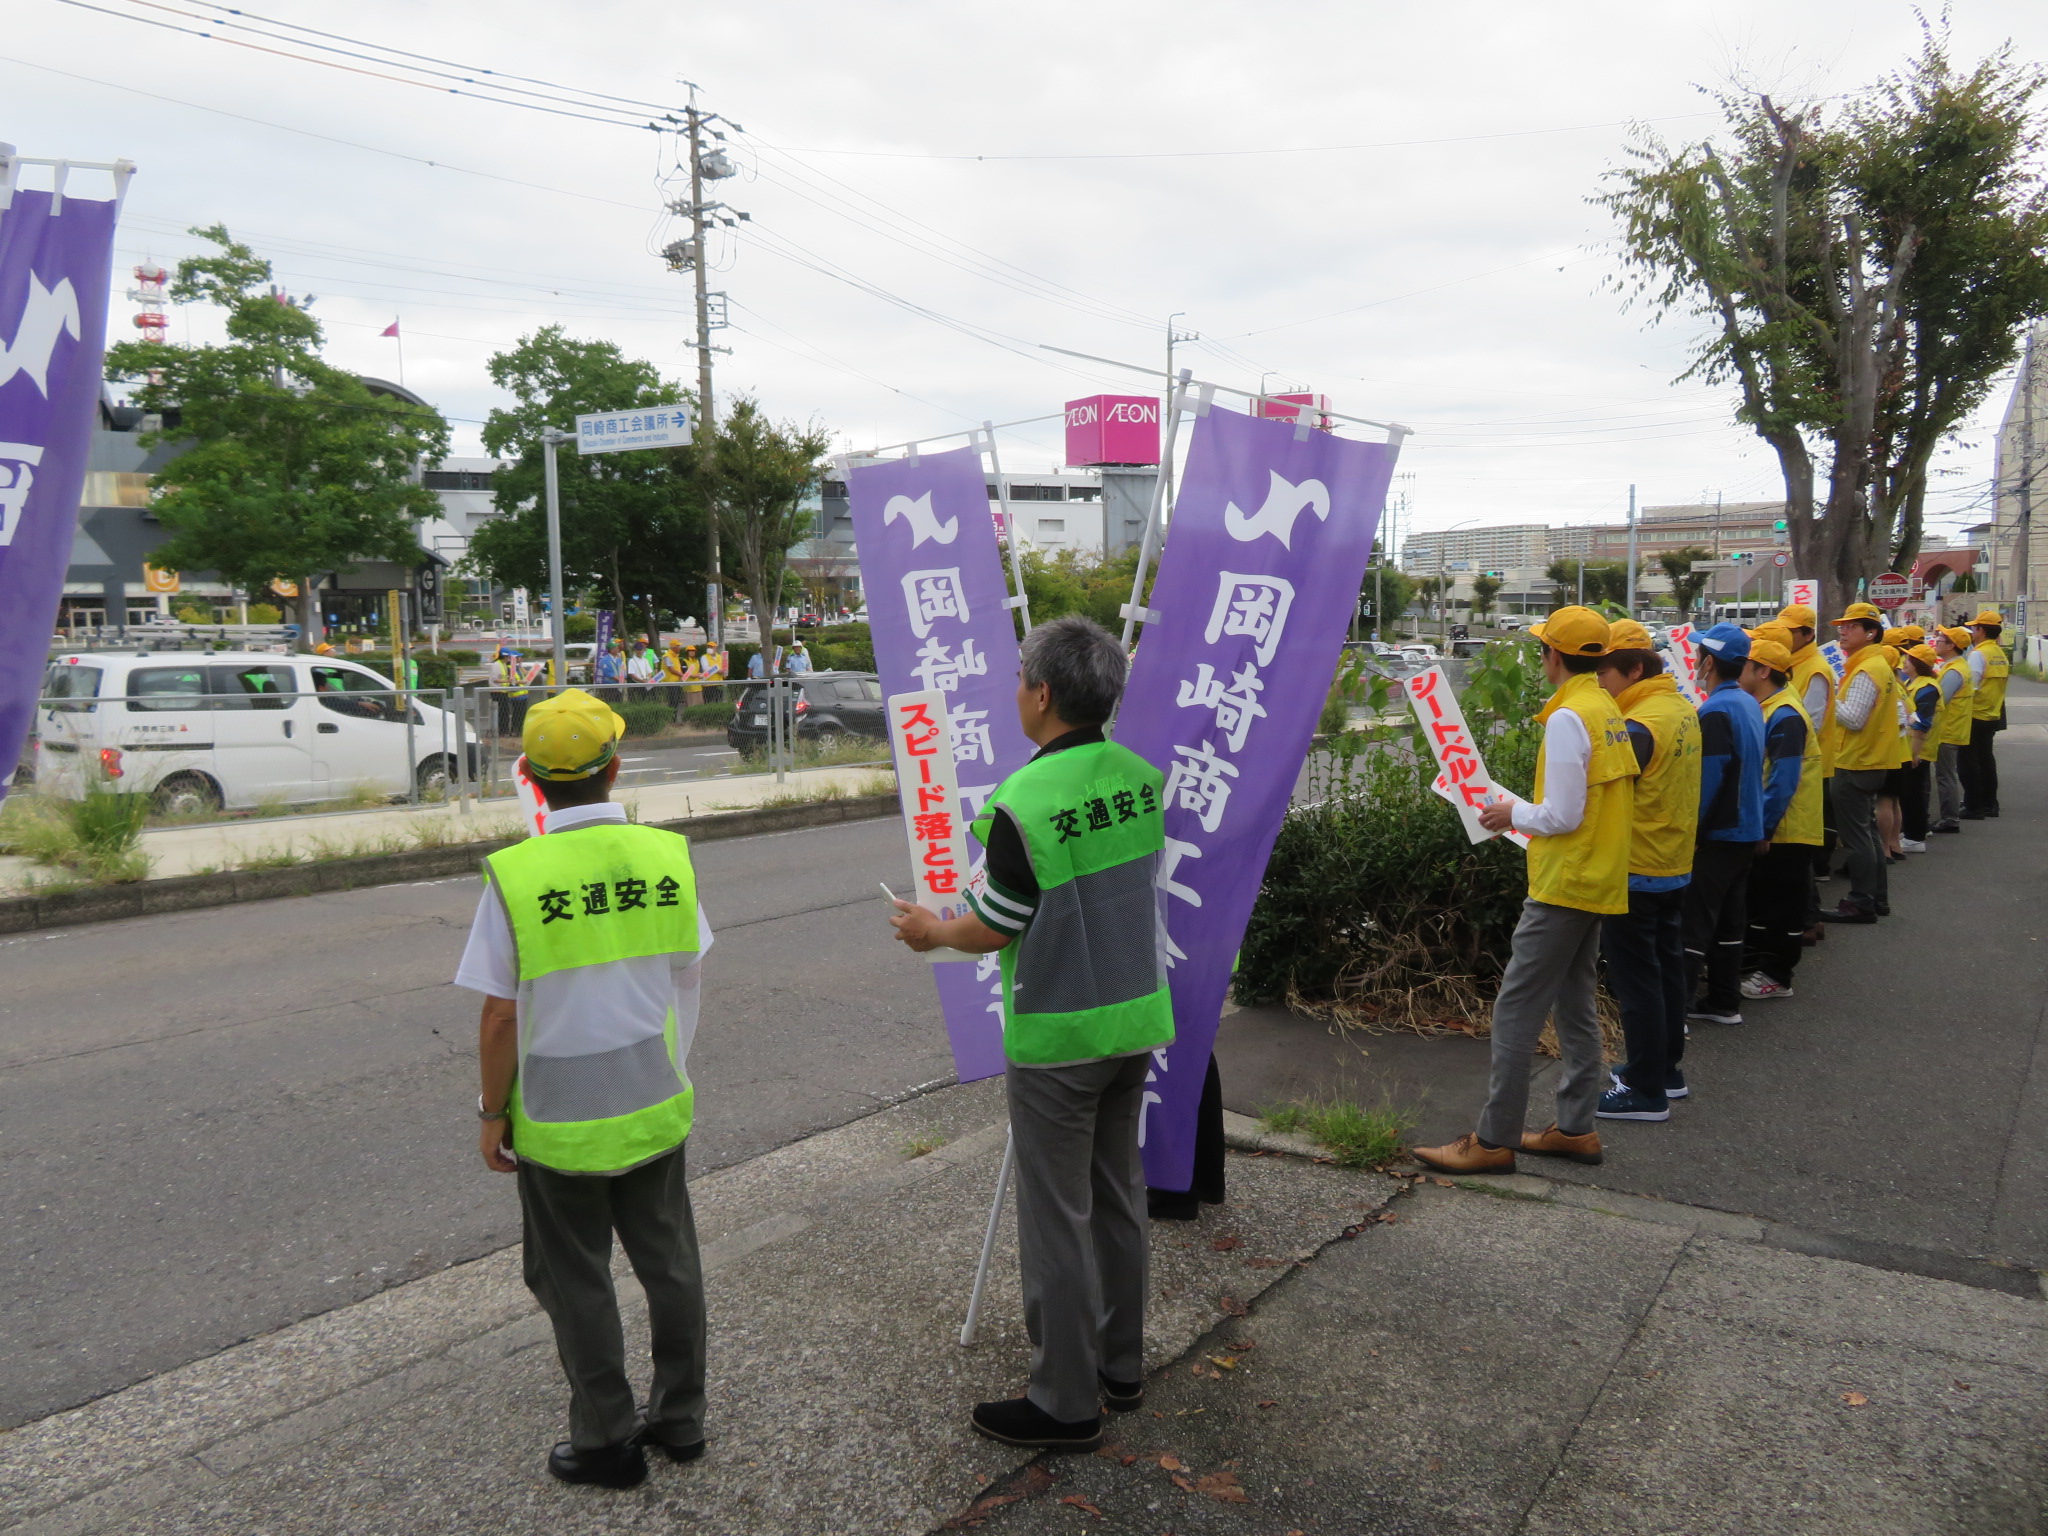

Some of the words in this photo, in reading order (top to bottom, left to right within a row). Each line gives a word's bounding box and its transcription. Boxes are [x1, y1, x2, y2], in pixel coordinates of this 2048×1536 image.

[582, 413, 669, 436] 岡崎商工会議所
[1411, 672, 1488, 807] シートベルト
[900, 703, 958, 894] スピード落とせ
[1049, 782, 1157, 845] 交通安全
[537, 875, 680, 925] 交通安全
